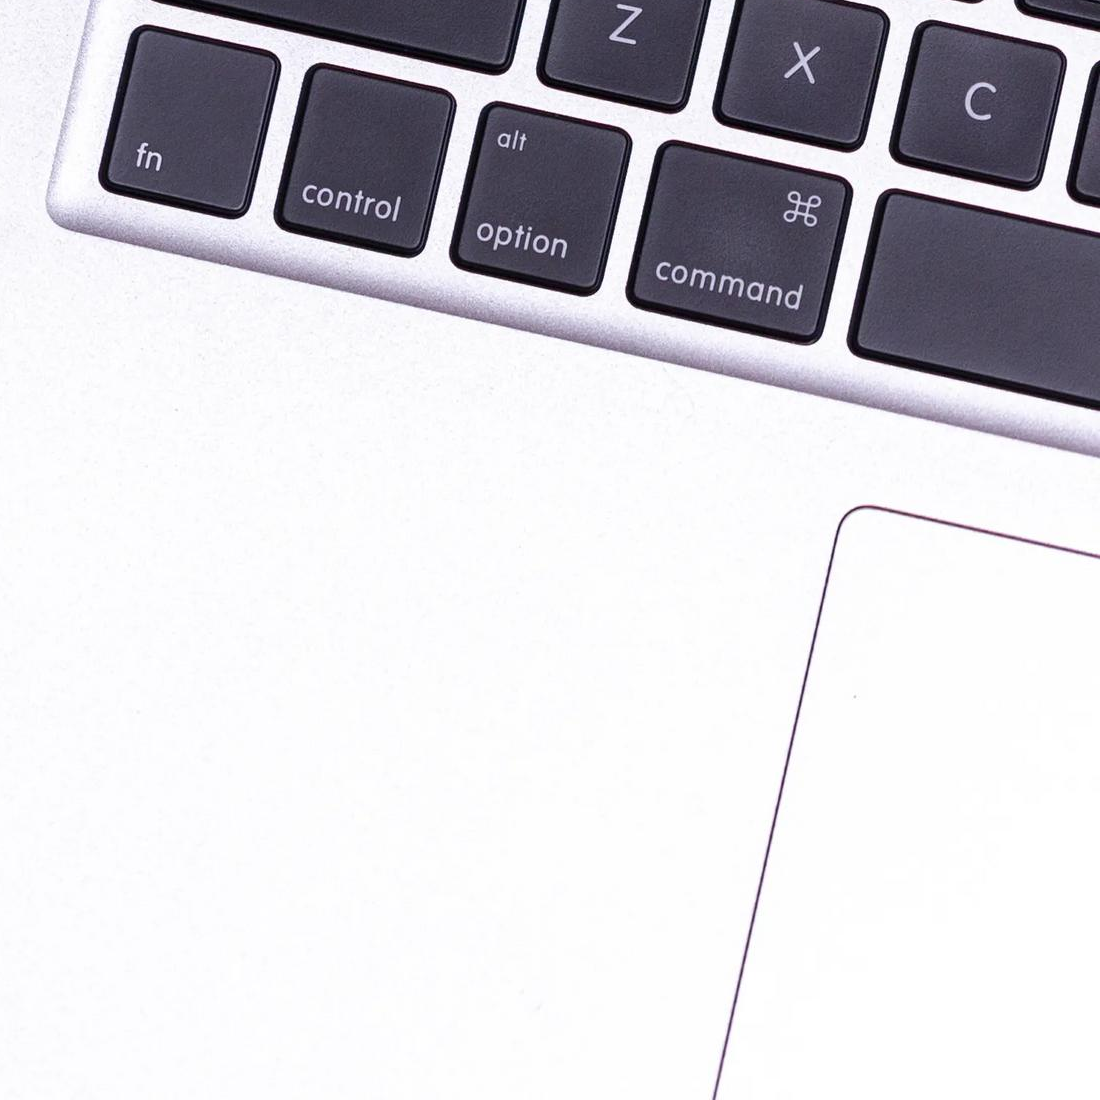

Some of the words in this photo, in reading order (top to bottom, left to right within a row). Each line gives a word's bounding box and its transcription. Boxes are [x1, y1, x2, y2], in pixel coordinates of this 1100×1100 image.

[608, 3, 643, 45] Z
[783, 41, 821, 85] X
[964, 81, 997, 121] C
[136, 142, 163, 172] fn
[497, 129, 527, 152] alt
[302, 184, 402, 222] control
[476, 222, 568, 259] option
[655, 260, 804, 311] command
